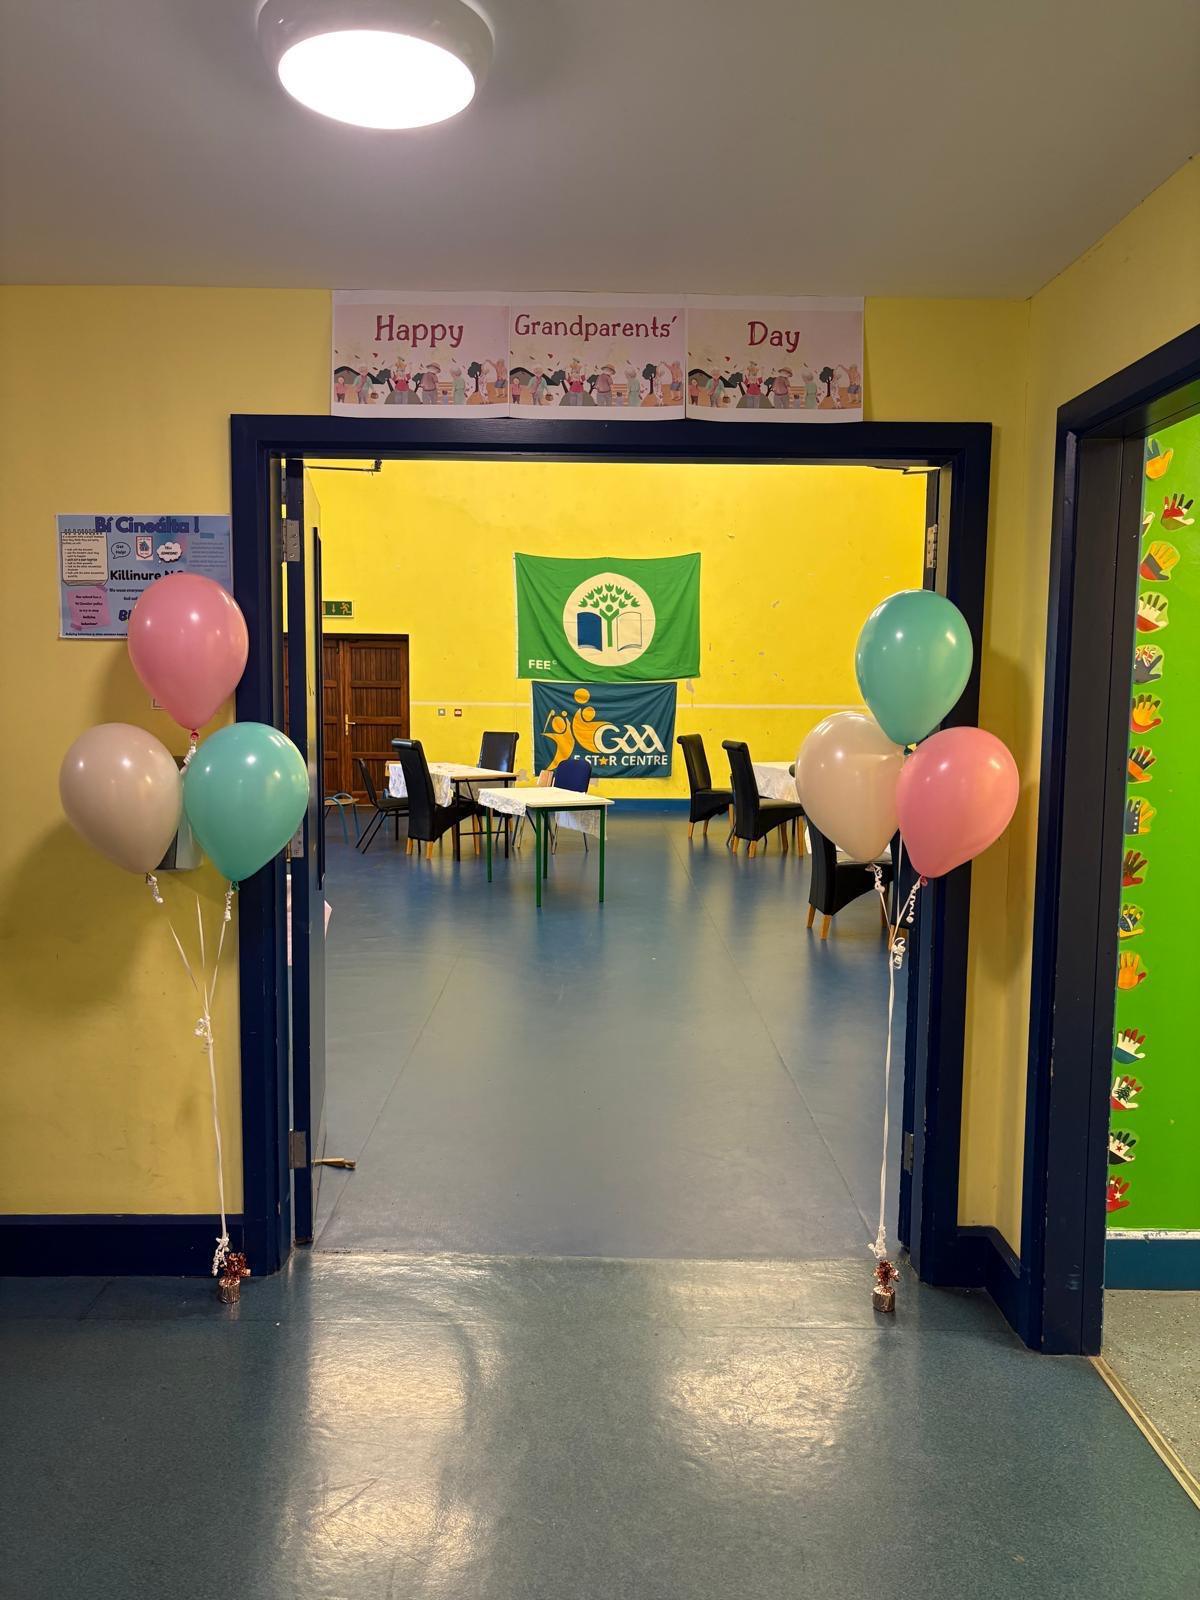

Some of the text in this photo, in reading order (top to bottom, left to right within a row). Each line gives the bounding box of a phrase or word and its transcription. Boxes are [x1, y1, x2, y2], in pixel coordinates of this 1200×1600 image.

[374, 314, 464, 348] Happy
[747, 320, 801, 353] Day
[94, 516, 114, 533] Bí
[115, 516, 190, 533] Cineálta
[109, 569, 162, 581] Killinure
[594, 724, 666, 754] GAA
[621, 755, 668, 766] CENTRE
